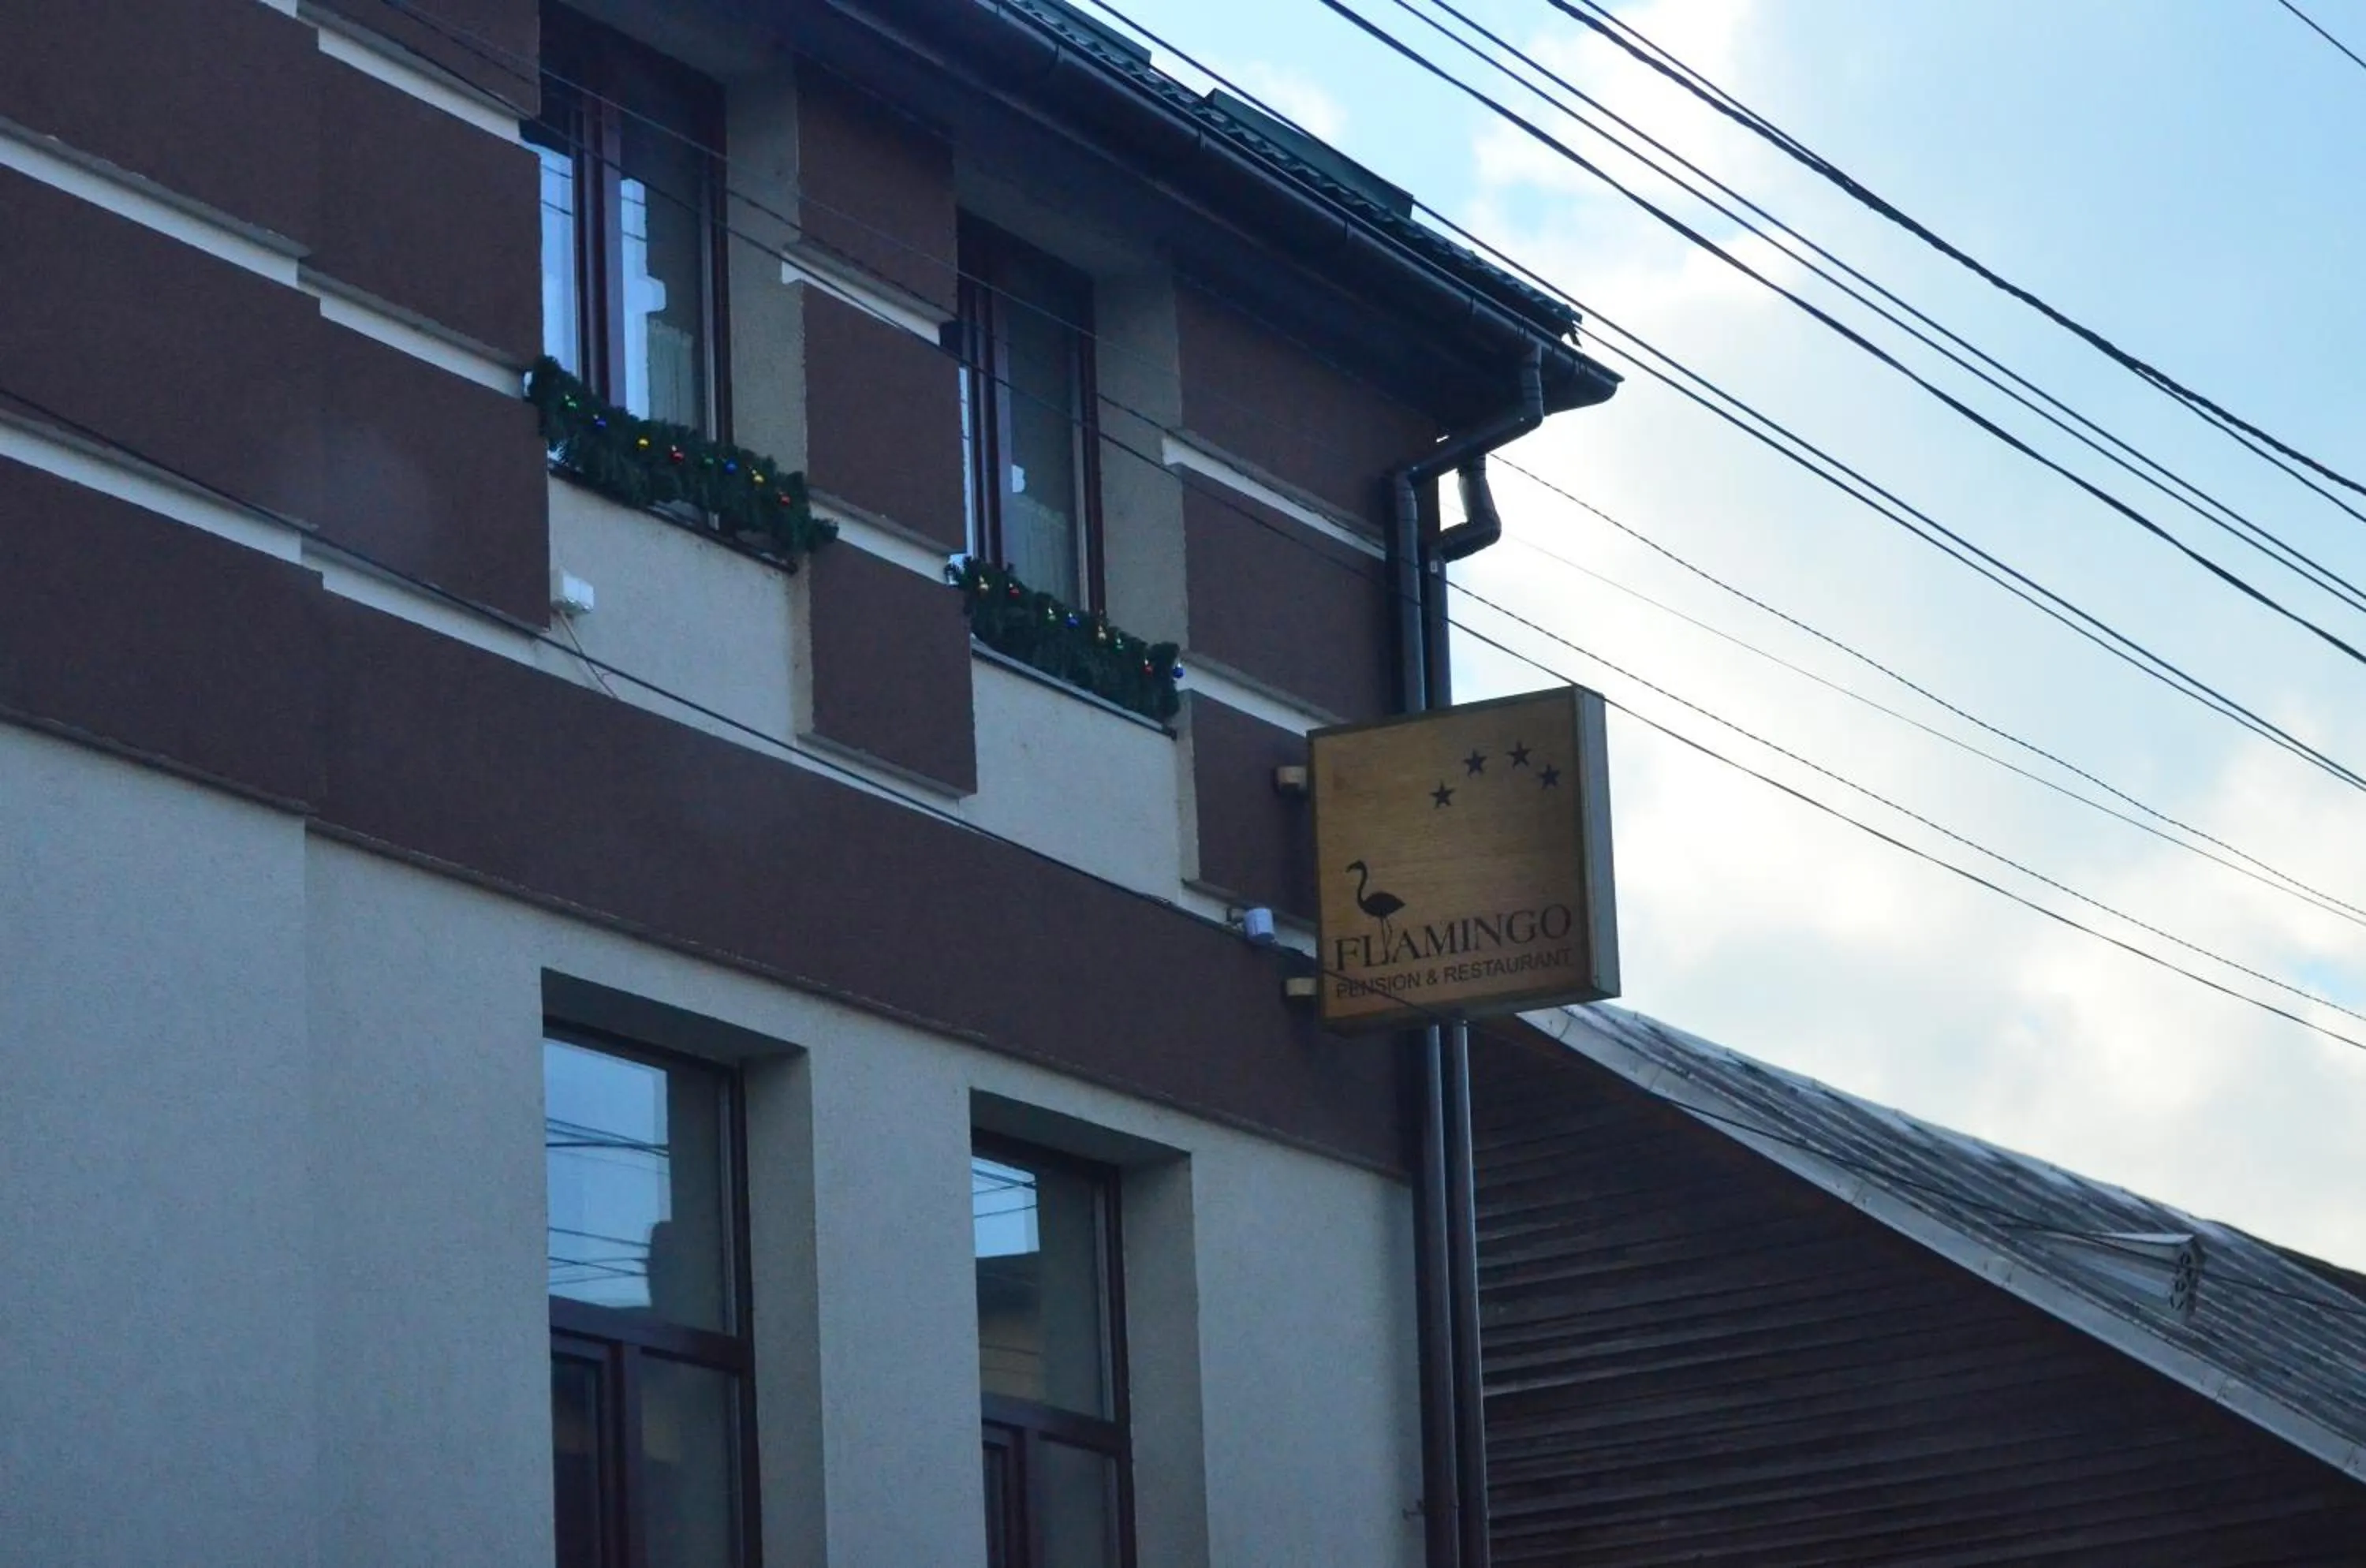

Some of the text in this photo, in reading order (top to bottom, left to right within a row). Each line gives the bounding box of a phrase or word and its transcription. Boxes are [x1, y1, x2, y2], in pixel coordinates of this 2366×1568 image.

[1335, 904, 1572, 971] FLAMINGO
[1336, 947, 1573, 998] PENSION & RESTAURANT
